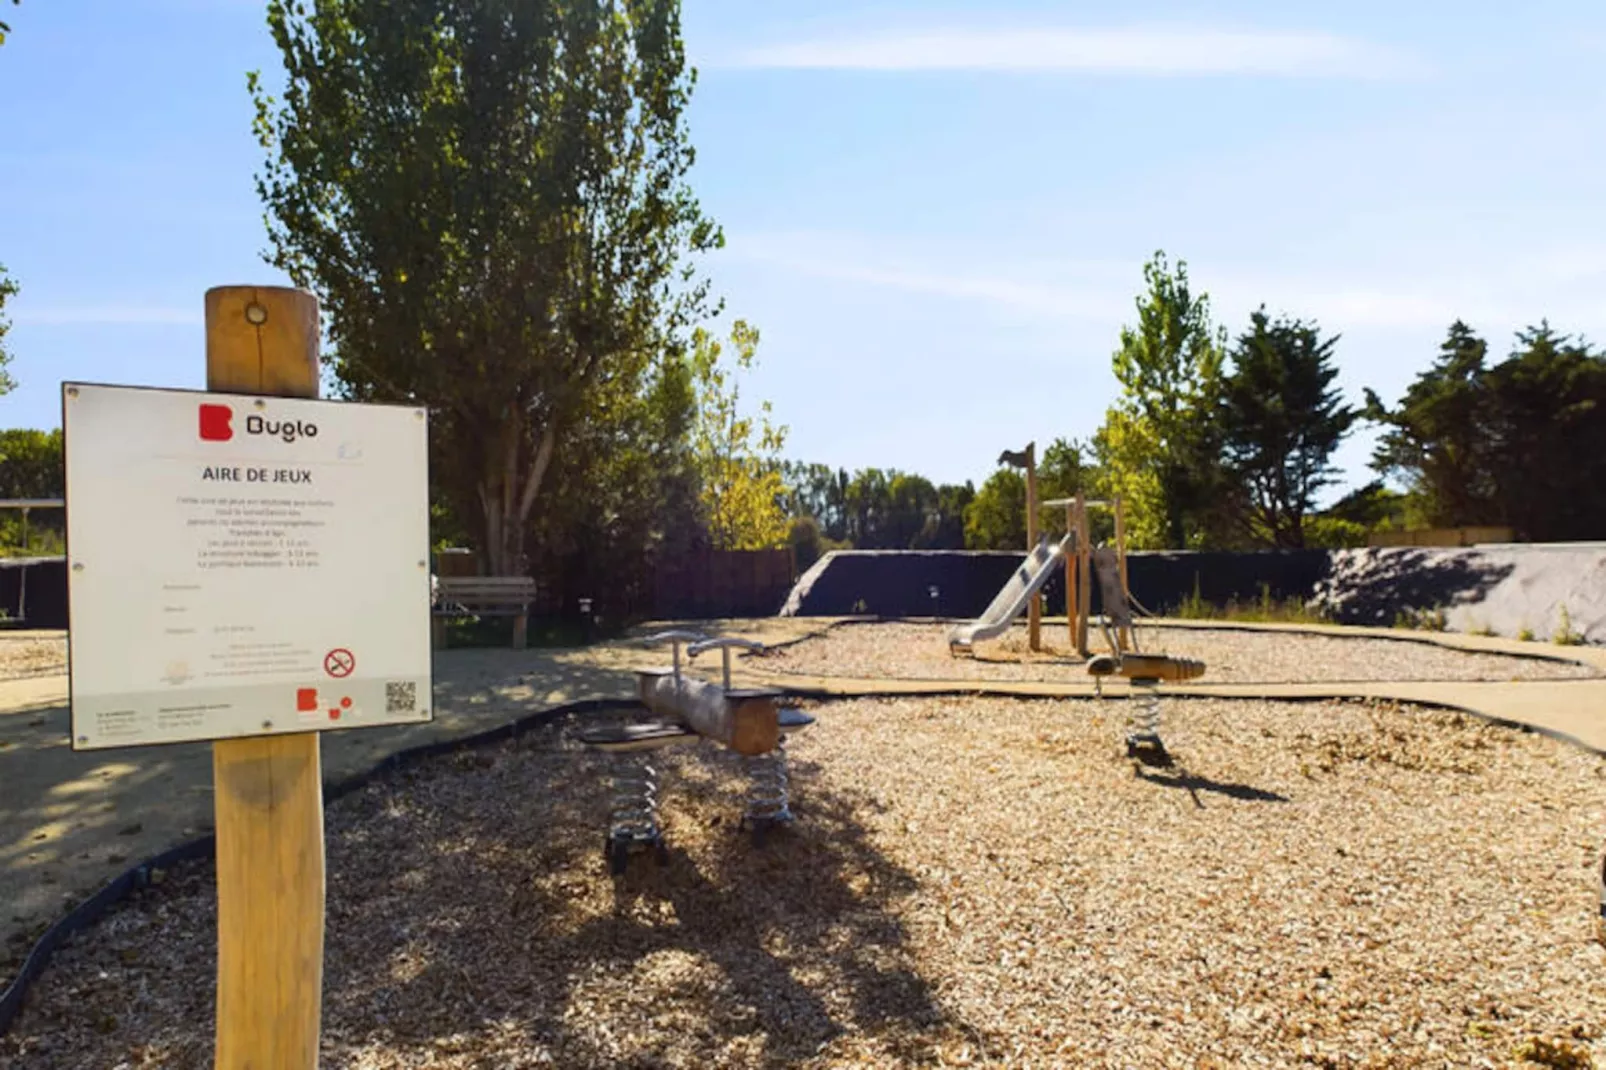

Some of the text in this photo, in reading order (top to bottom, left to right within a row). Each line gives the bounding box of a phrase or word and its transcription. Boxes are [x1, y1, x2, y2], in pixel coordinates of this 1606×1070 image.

[246, 415, 318, 443] Buglo
[202, 466, 312, 484] AIRE DE JEUX
